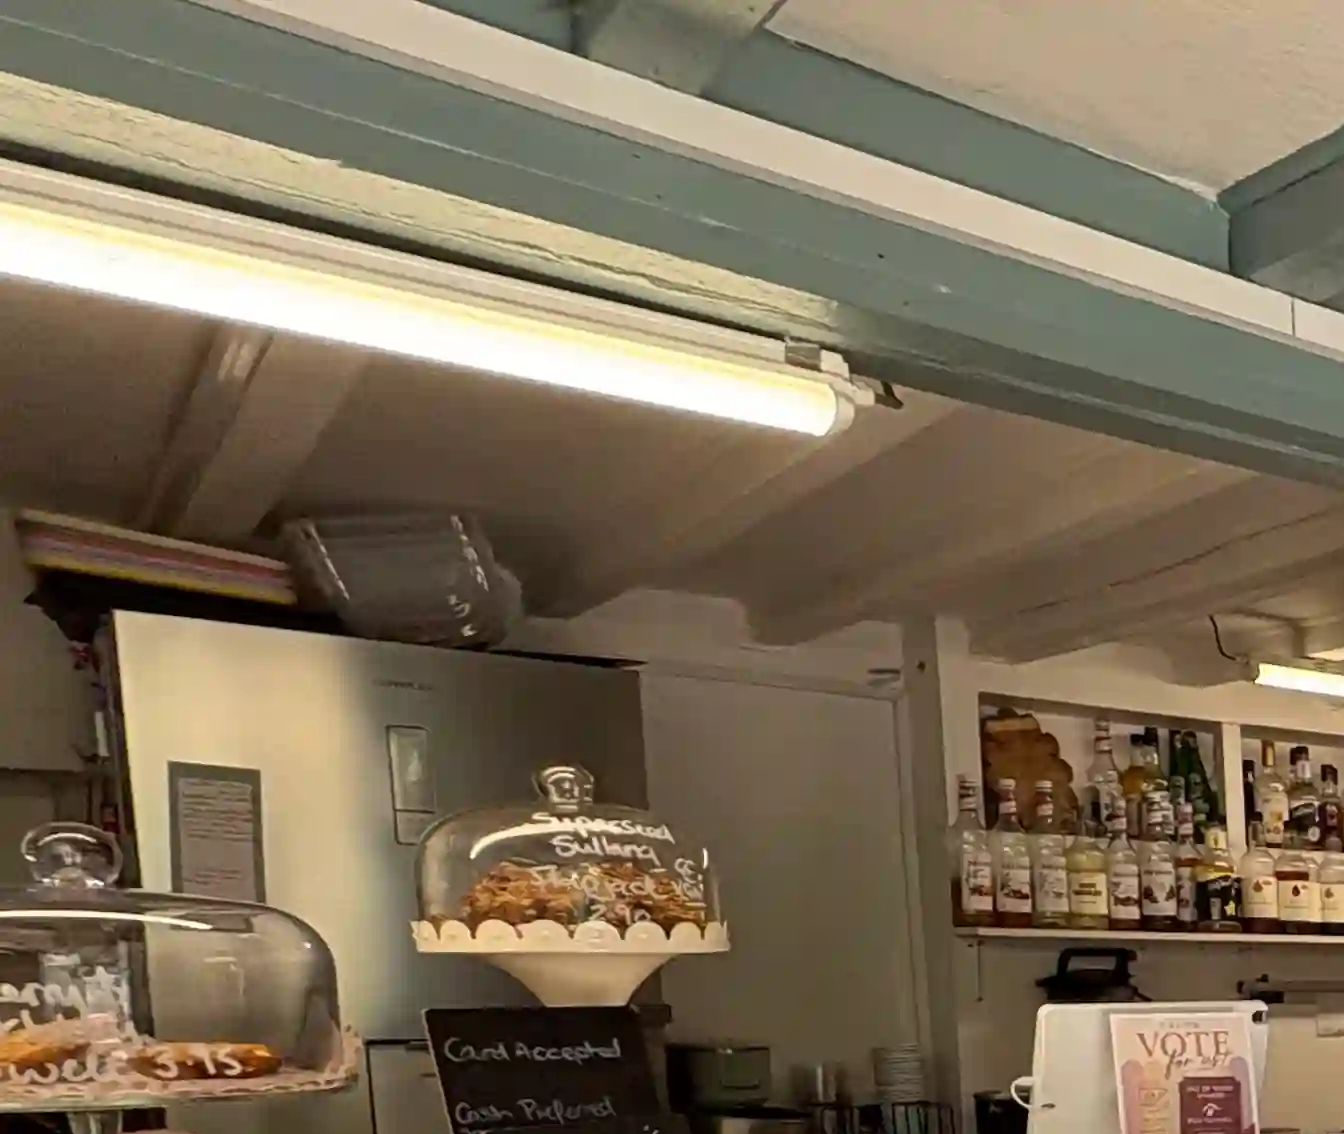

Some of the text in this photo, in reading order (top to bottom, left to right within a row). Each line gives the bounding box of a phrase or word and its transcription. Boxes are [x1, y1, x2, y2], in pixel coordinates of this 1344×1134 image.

[444, 1037, 622, 1065] Card Accepted
[1136, 1030, 1229, 1057] VOTE
